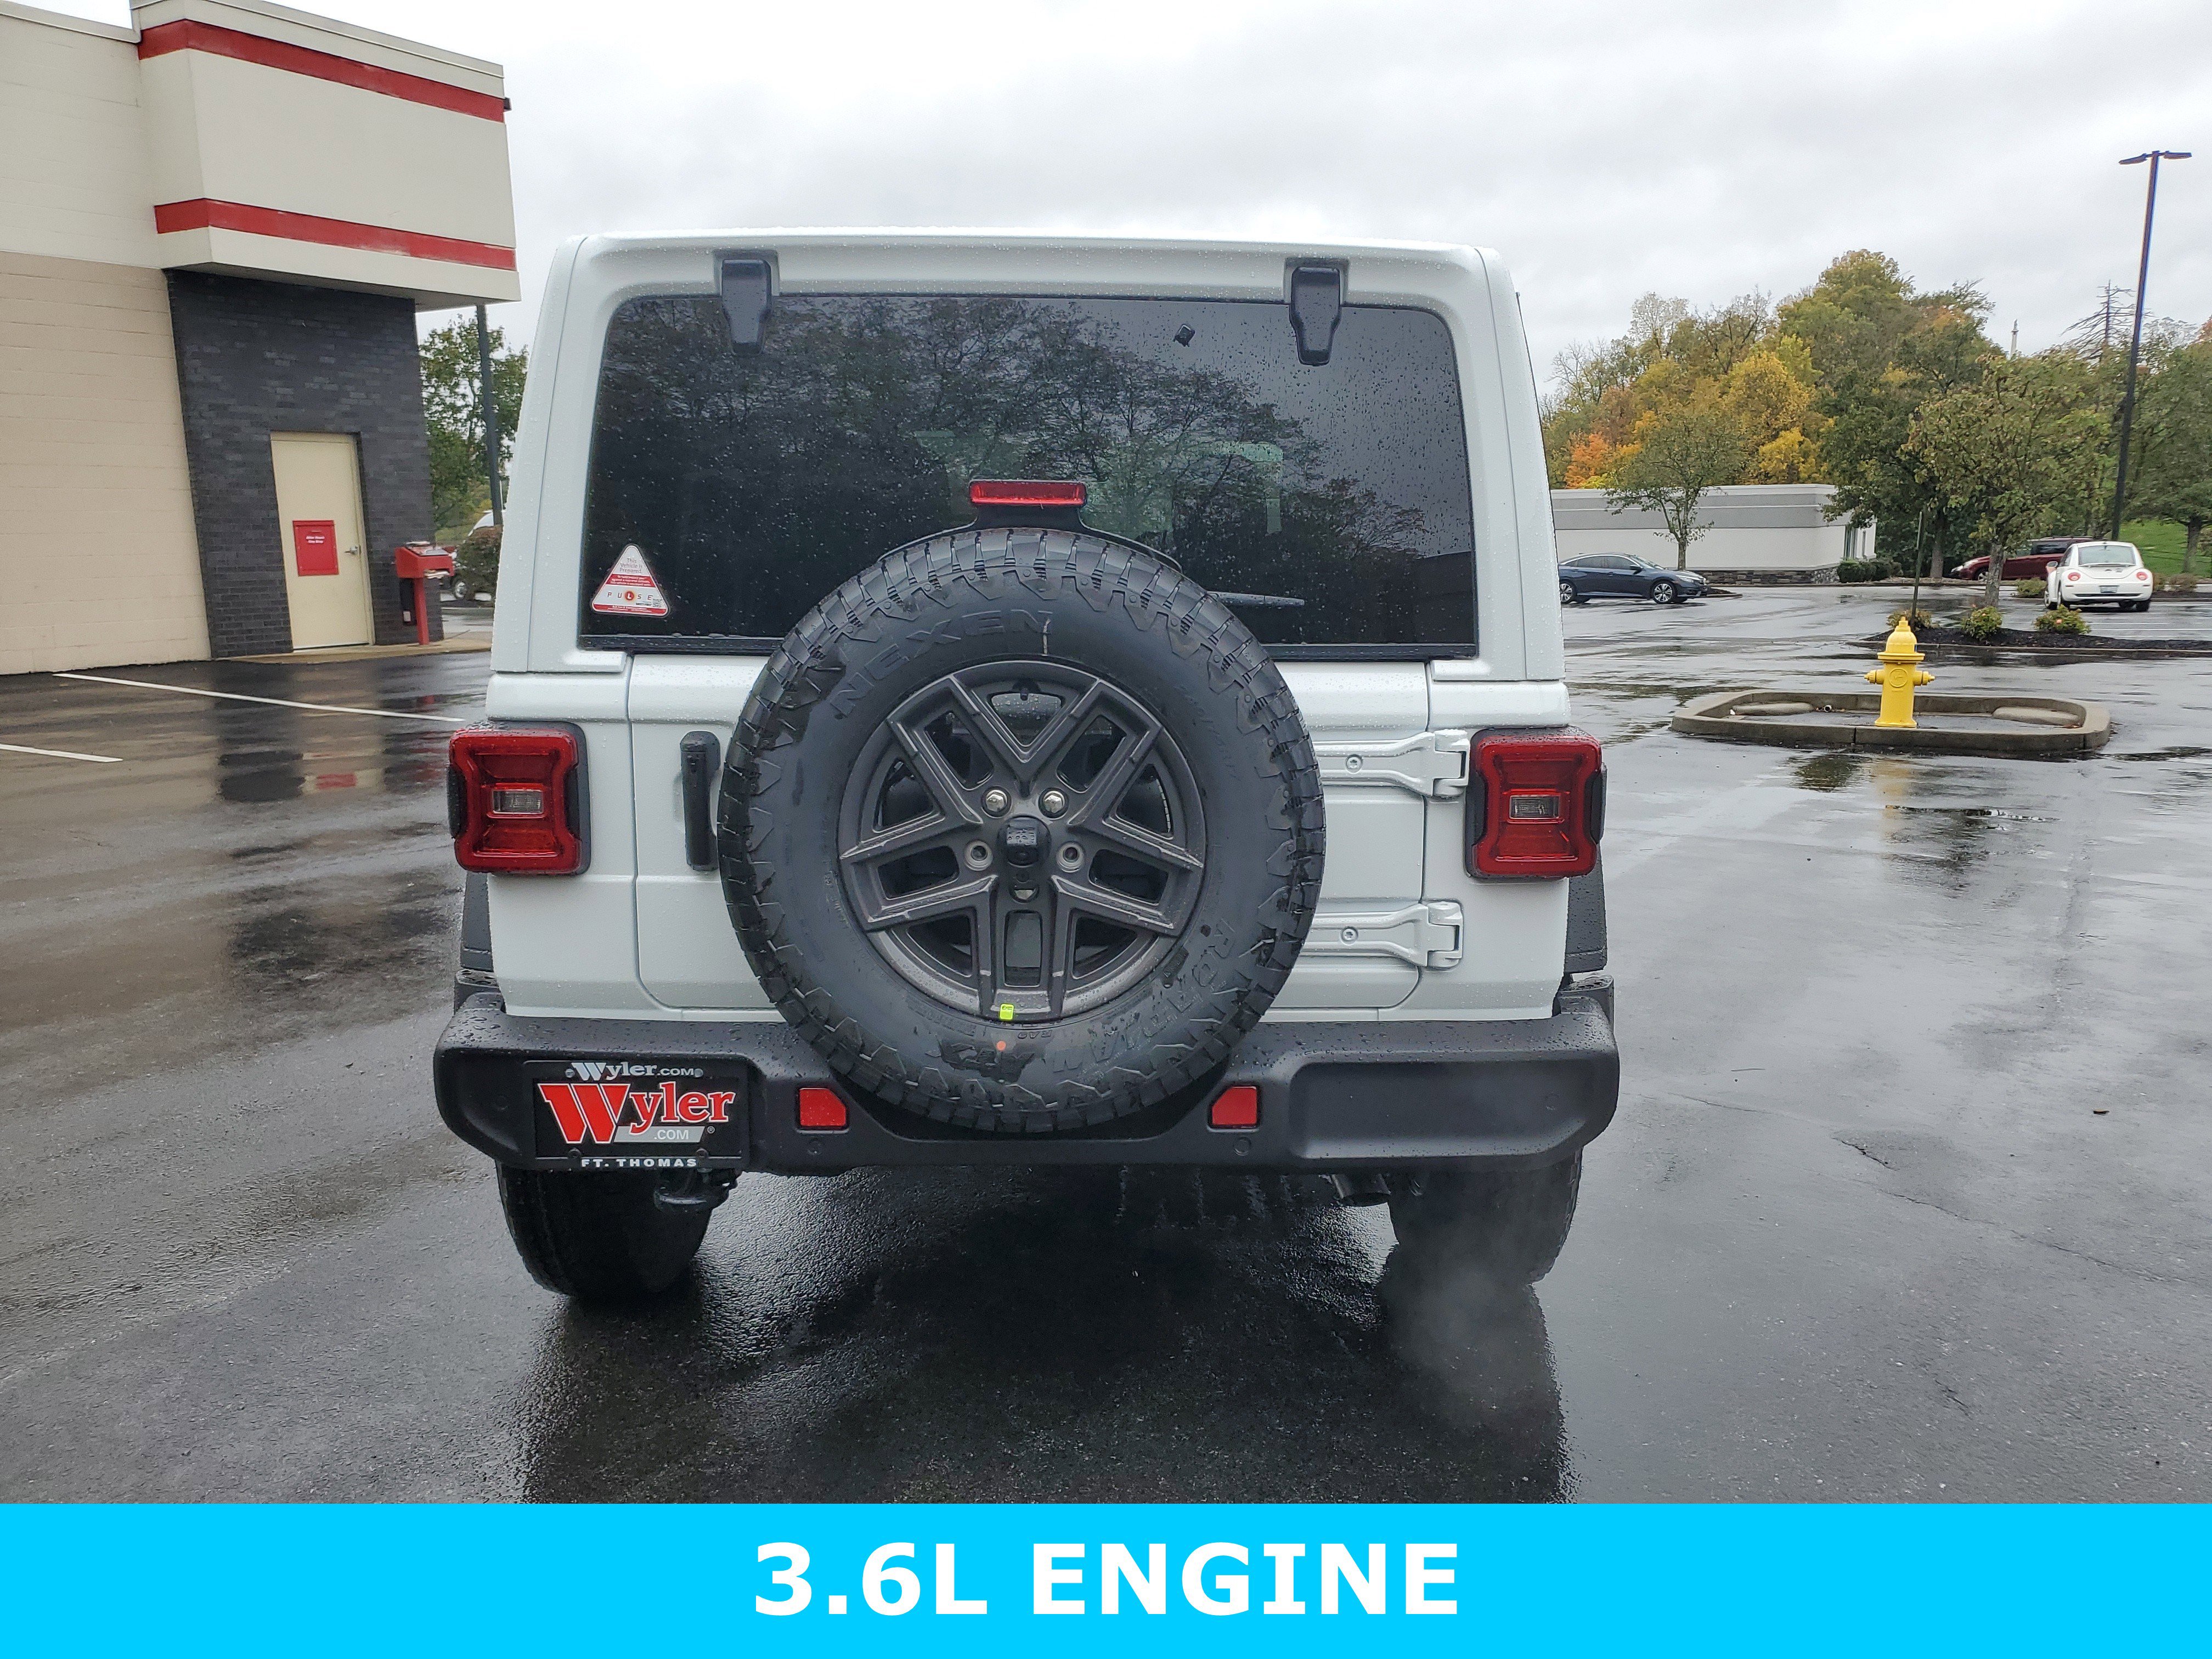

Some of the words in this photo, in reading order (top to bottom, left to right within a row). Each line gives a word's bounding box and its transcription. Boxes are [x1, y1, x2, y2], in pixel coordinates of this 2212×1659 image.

[607, 591, 653, 601] PULSE
[831, 609, 1053, 717] NEXEN
[537, 1081, 736, 1144] Wyler
[581, 1158, 610, 1167] FT.
[619, 1158, 697, 1167] THOMAS
